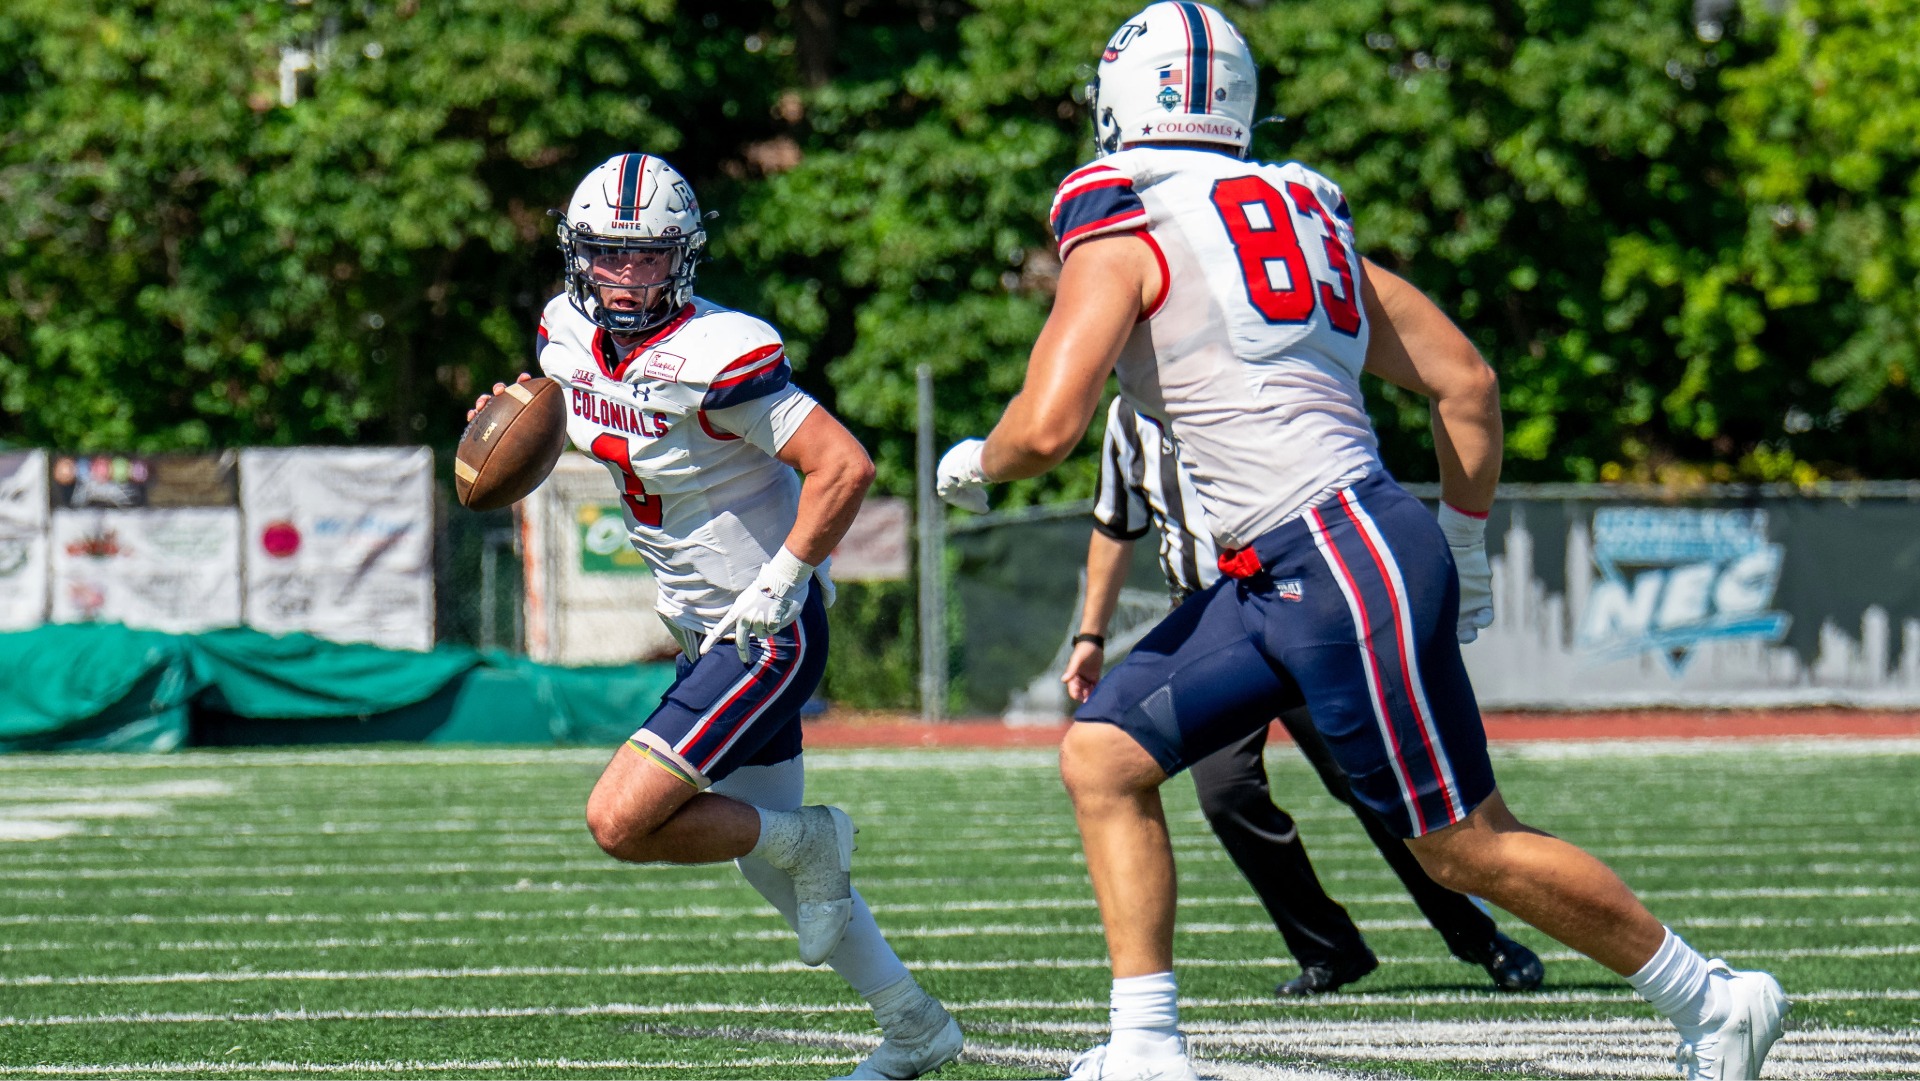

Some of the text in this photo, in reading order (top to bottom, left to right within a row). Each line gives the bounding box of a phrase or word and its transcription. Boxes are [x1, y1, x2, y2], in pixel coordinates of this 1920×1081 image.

[1157, 122, 1232, 136] COLONIALS
[611, 221, 641, 231] UNITE
[1209, 175, 1361, 338] 83
[572, 388, 669, 439] COLONIALS
[1586, 546, 1780, 637] NEC
